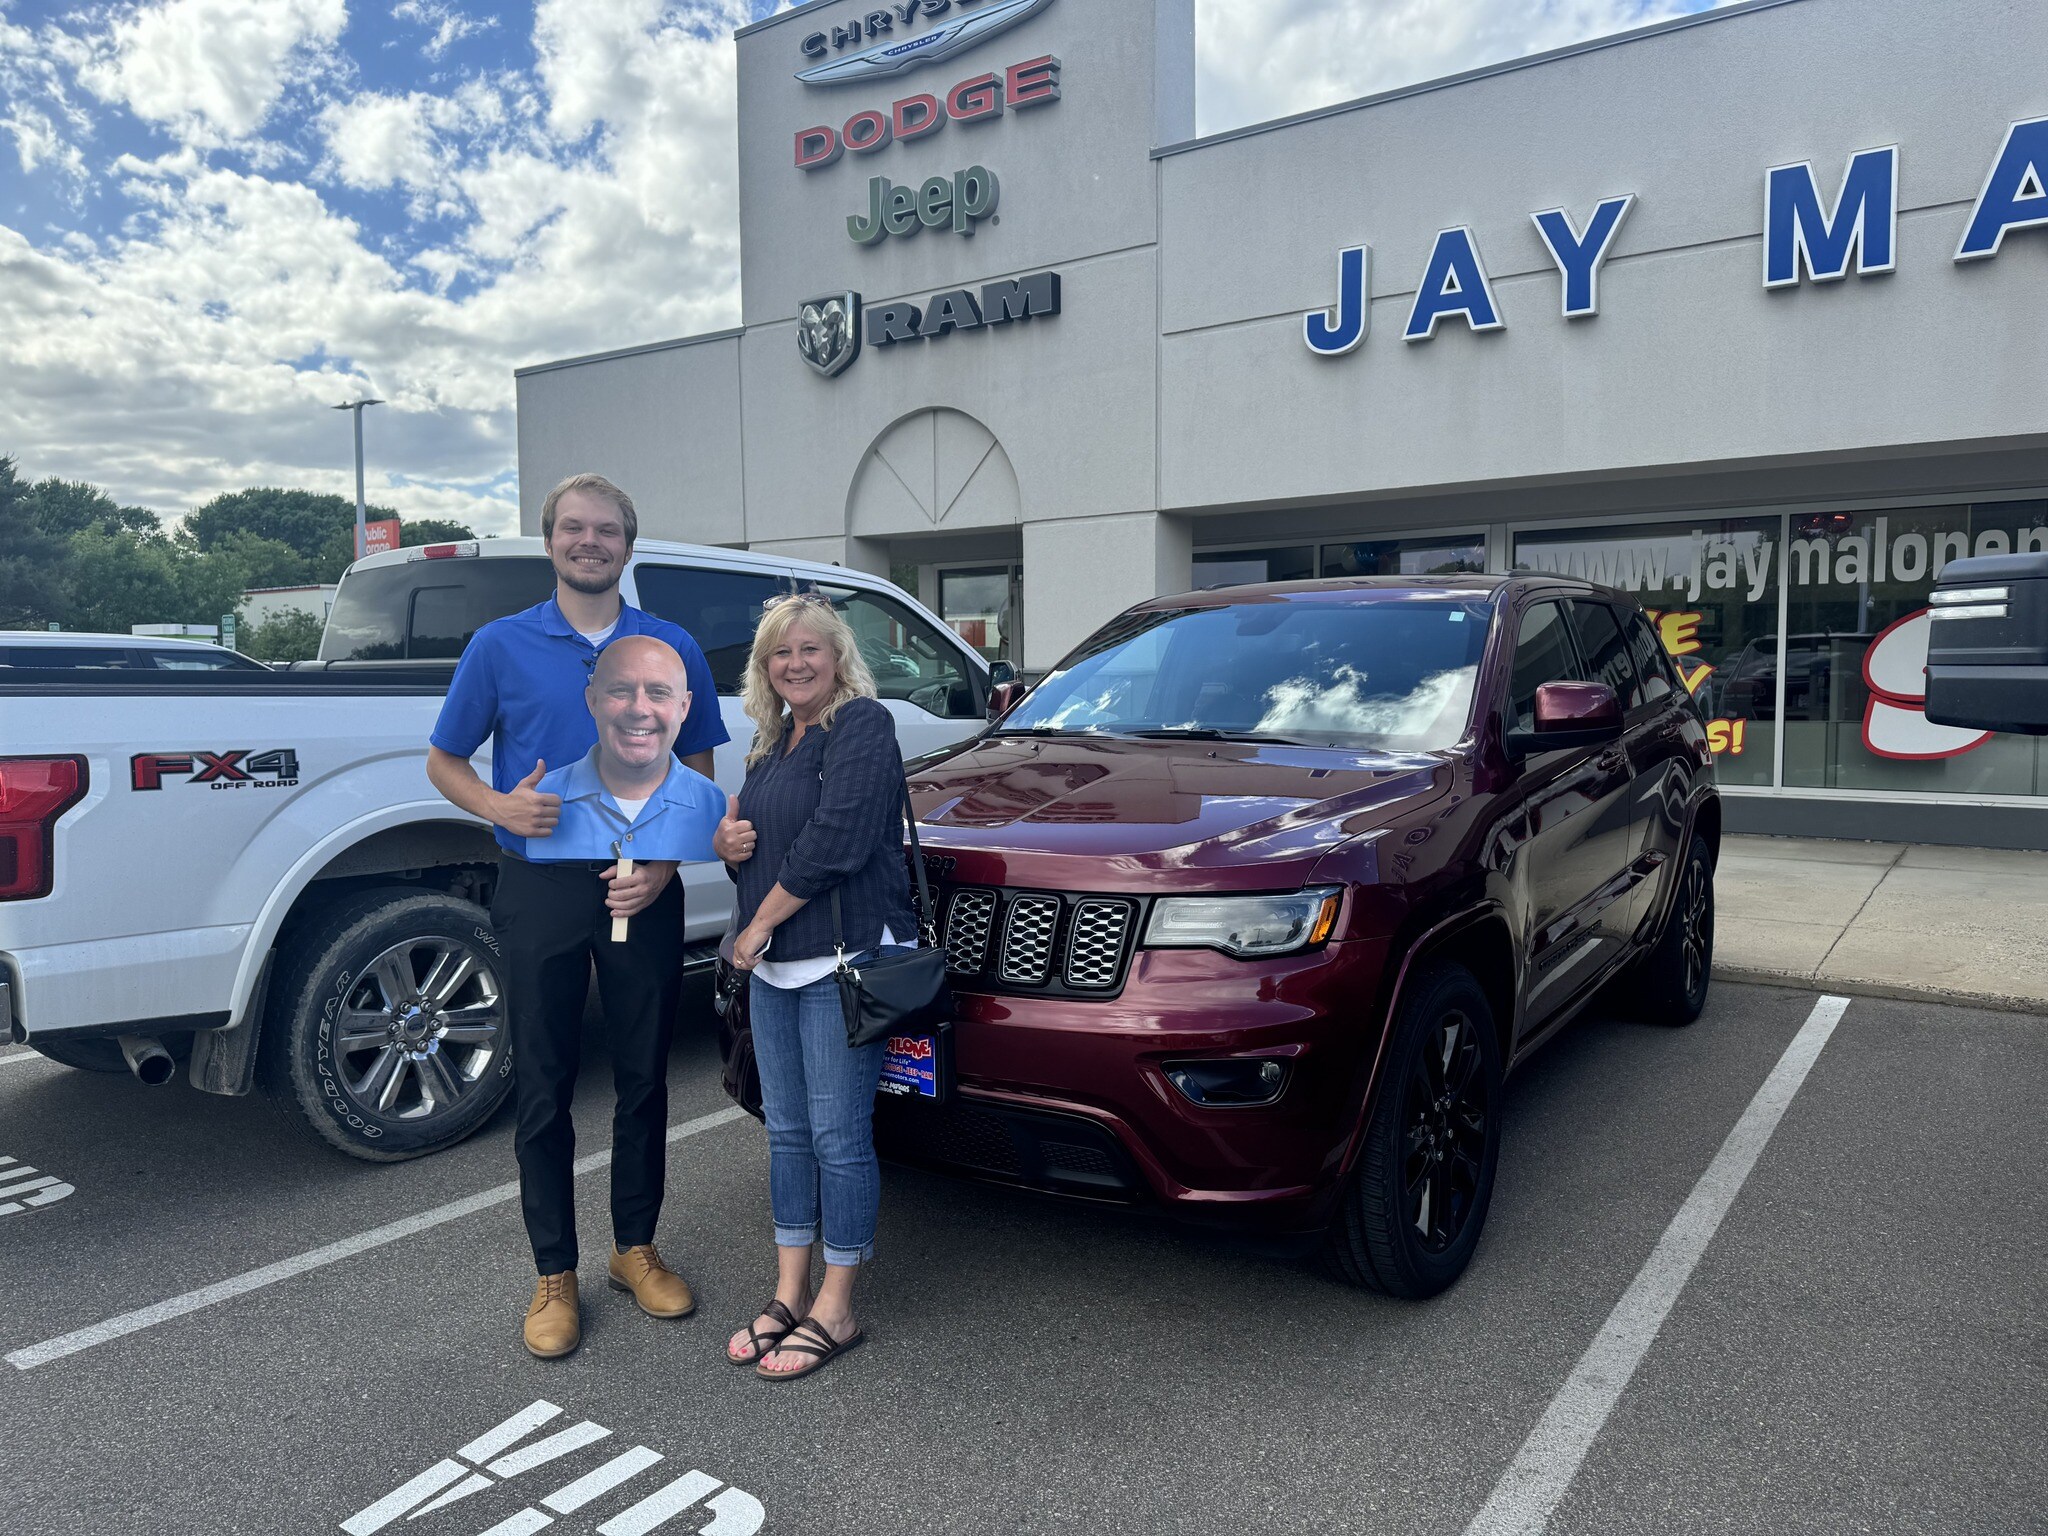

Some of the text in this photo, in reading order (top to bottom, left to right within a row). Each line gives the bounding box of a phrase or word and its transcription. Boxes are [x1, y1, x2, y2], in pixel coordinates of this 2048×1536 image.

[800, 0, 976, 57] CHRYS
[887, 35, 938, 56] CHRYSLER
[795, 54, 1061, 171] DODGE
[846, 164, 999, 246] Jeep
[1303, 193, 1638, 356] JAY
[866, 271, 1061, 347] RAM
[365, 526, 387, 541] ublic
[129, 748, 299, 792] FX4
[210, 779, 299, 790] OFF ROAD
[885, 1037, 932, 1059] ALONE
[881, 1072, 920, 1084] onemotors.com
